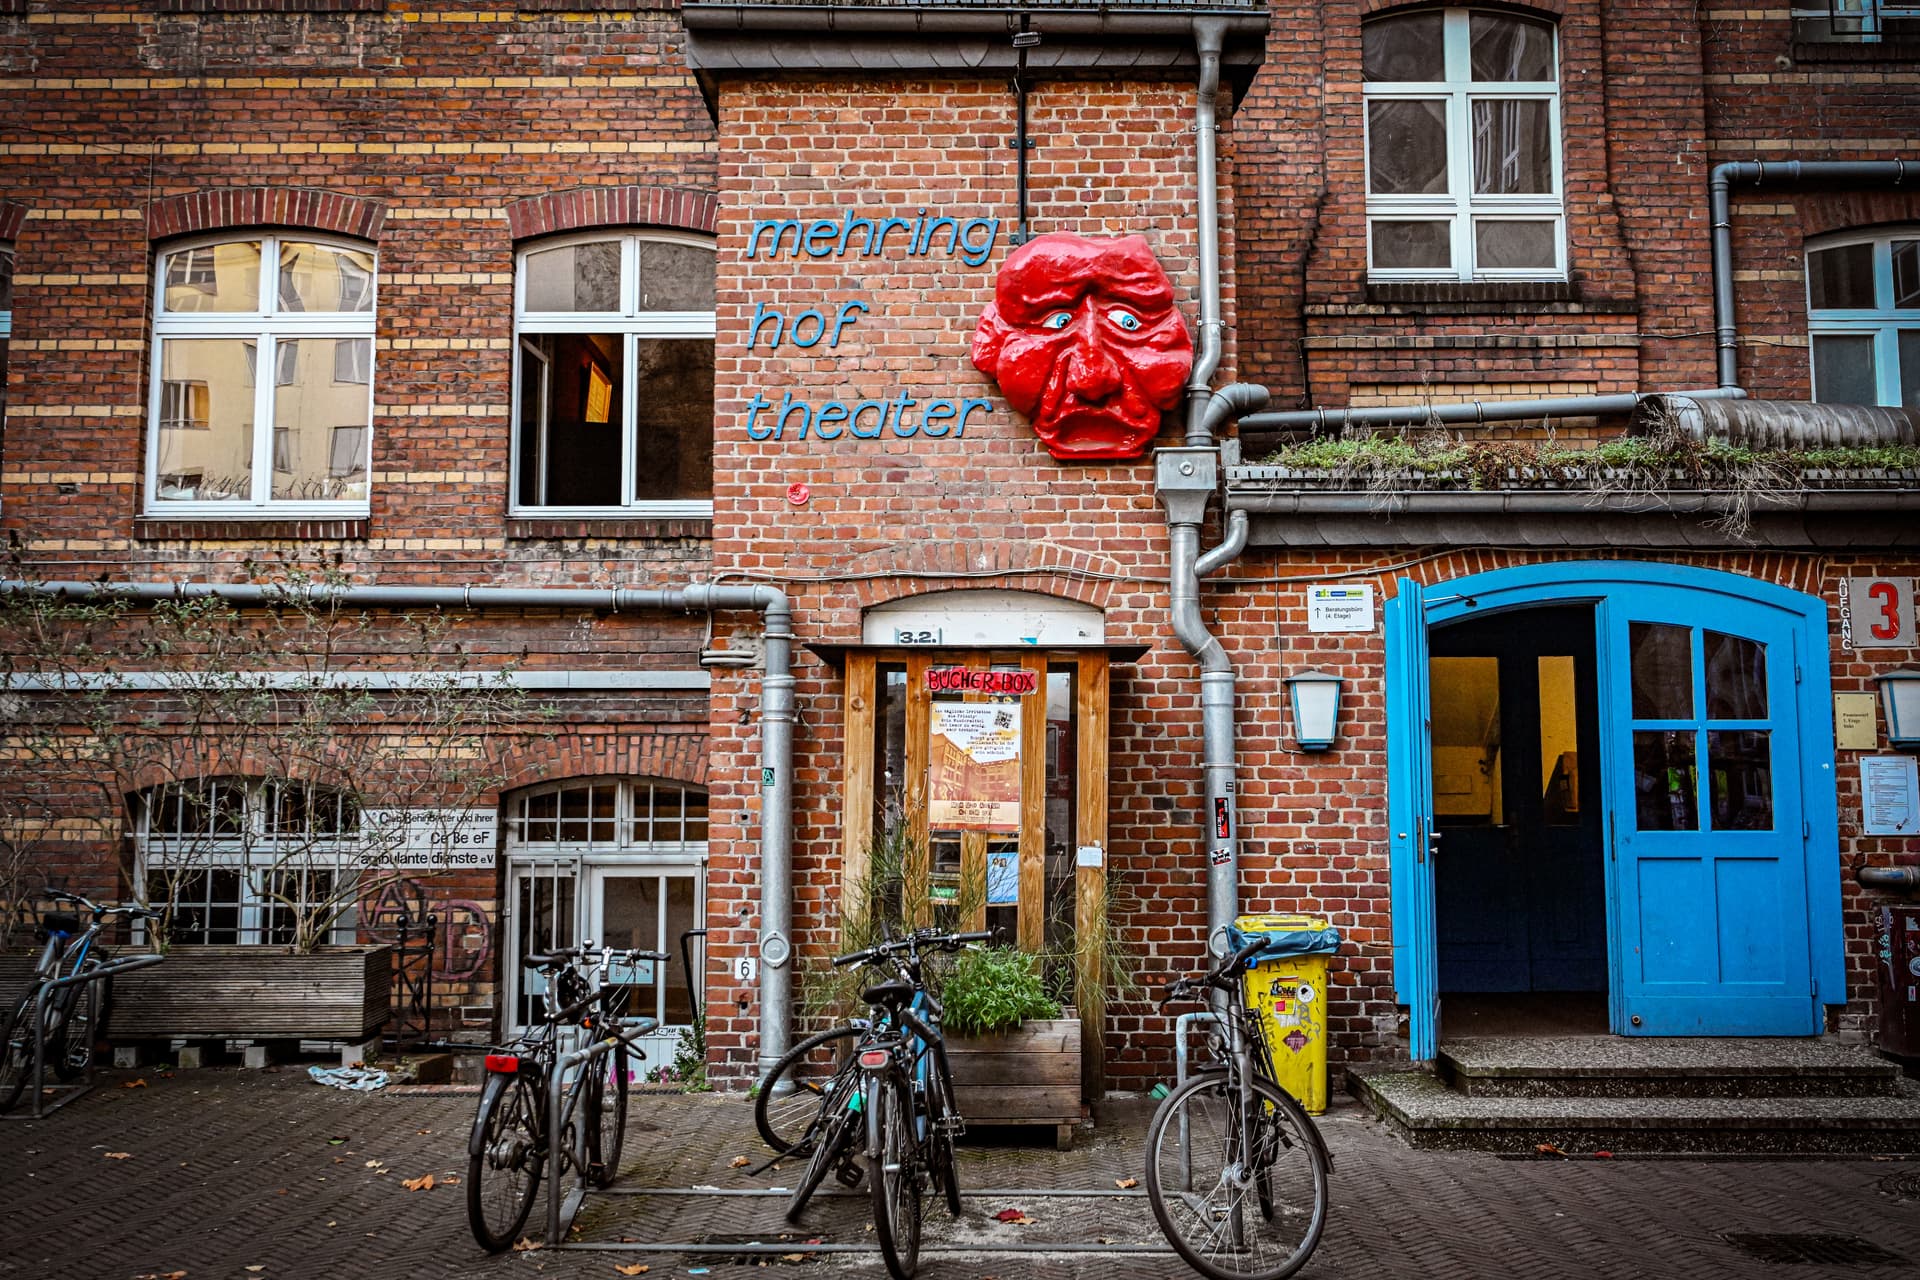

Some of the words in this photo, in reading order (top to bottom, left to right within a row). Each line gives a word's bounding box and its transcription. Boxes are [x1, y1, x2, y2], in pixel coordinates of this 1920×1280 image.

[747, 207, 1000, 267] mehring
[747, 300, 869, 349] hof
[747, 390, 993, 440] theater
[1869, 582, 1900, 640] 3
[900, 631, 937, 644] 3.2.
[474, 814, 493, 822] ihrer
[473, 832, 490, 844] eF
[740, 961, 750, 976] 6
